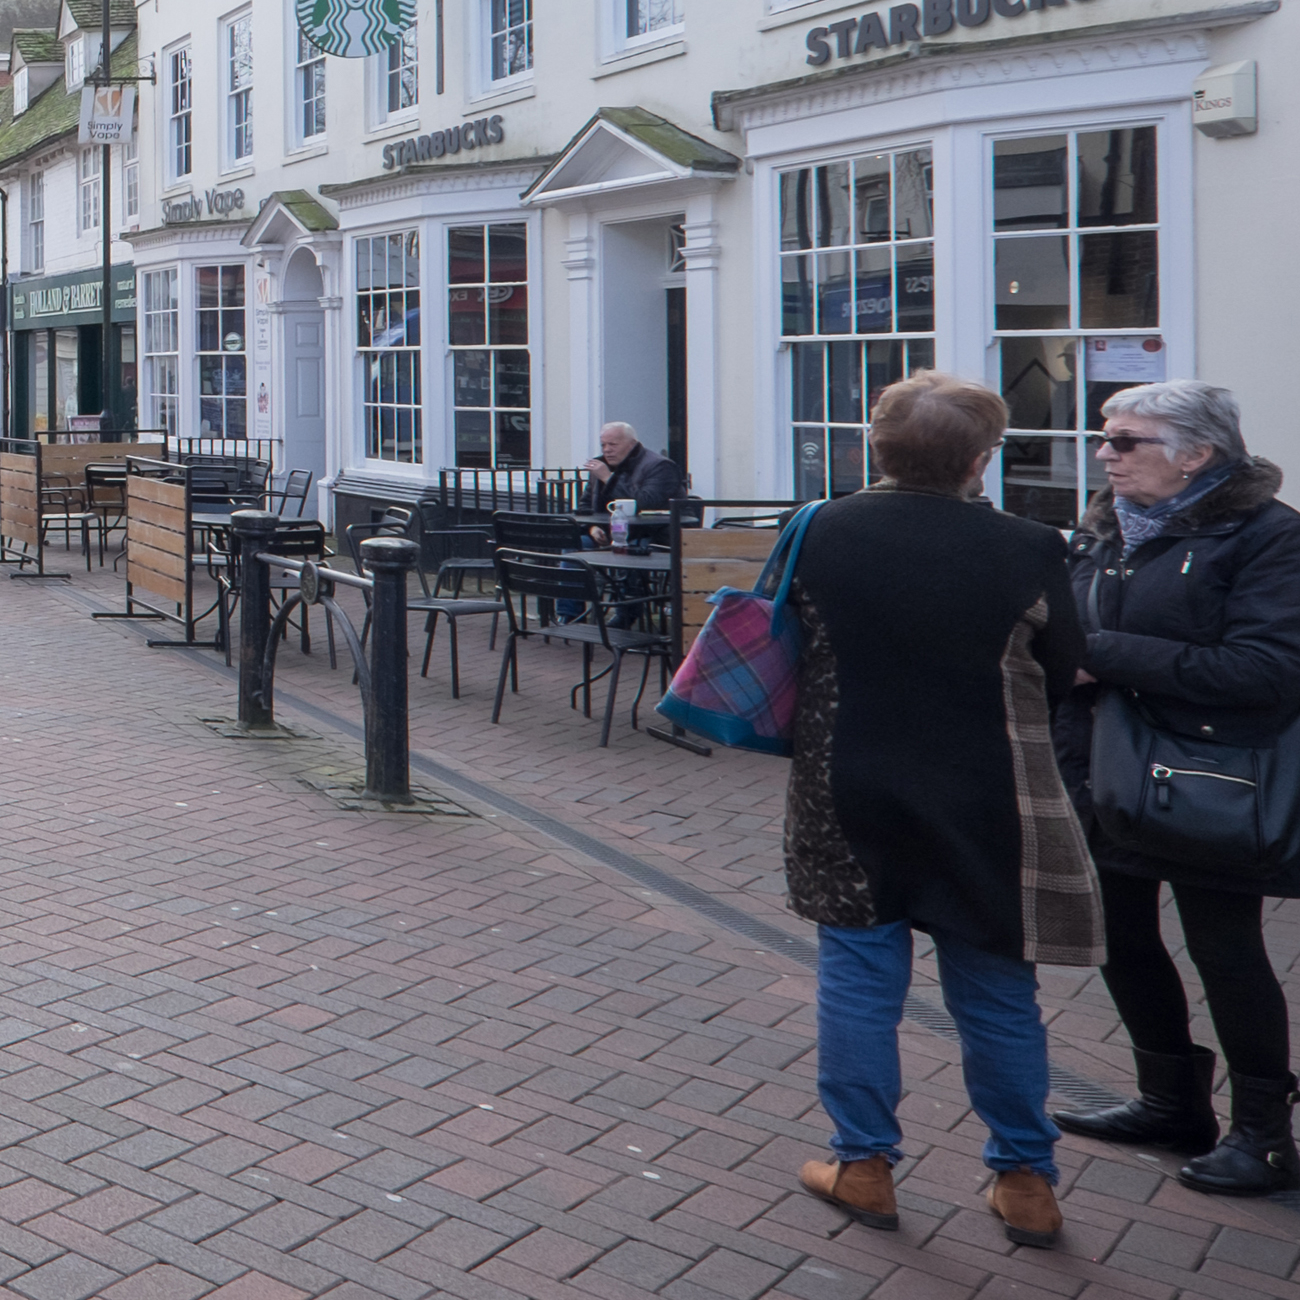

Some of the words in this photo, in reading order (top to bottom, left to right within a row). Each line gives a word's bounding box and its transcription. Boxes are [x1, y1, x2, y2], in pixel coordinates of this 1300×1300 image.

[1194, 97, 1232, 112] KINGS
[87, 121, 123, 132] Simply
[89, 130, 120, 140] Vape
[383, 115, 504, 170] STARBUCKS
[162, 194, 203, 225] Simply
[205, 187, 246, 219] Vape
[30, 288, 62, 318] HOLLAND
[62, 286, 70, 314] &
